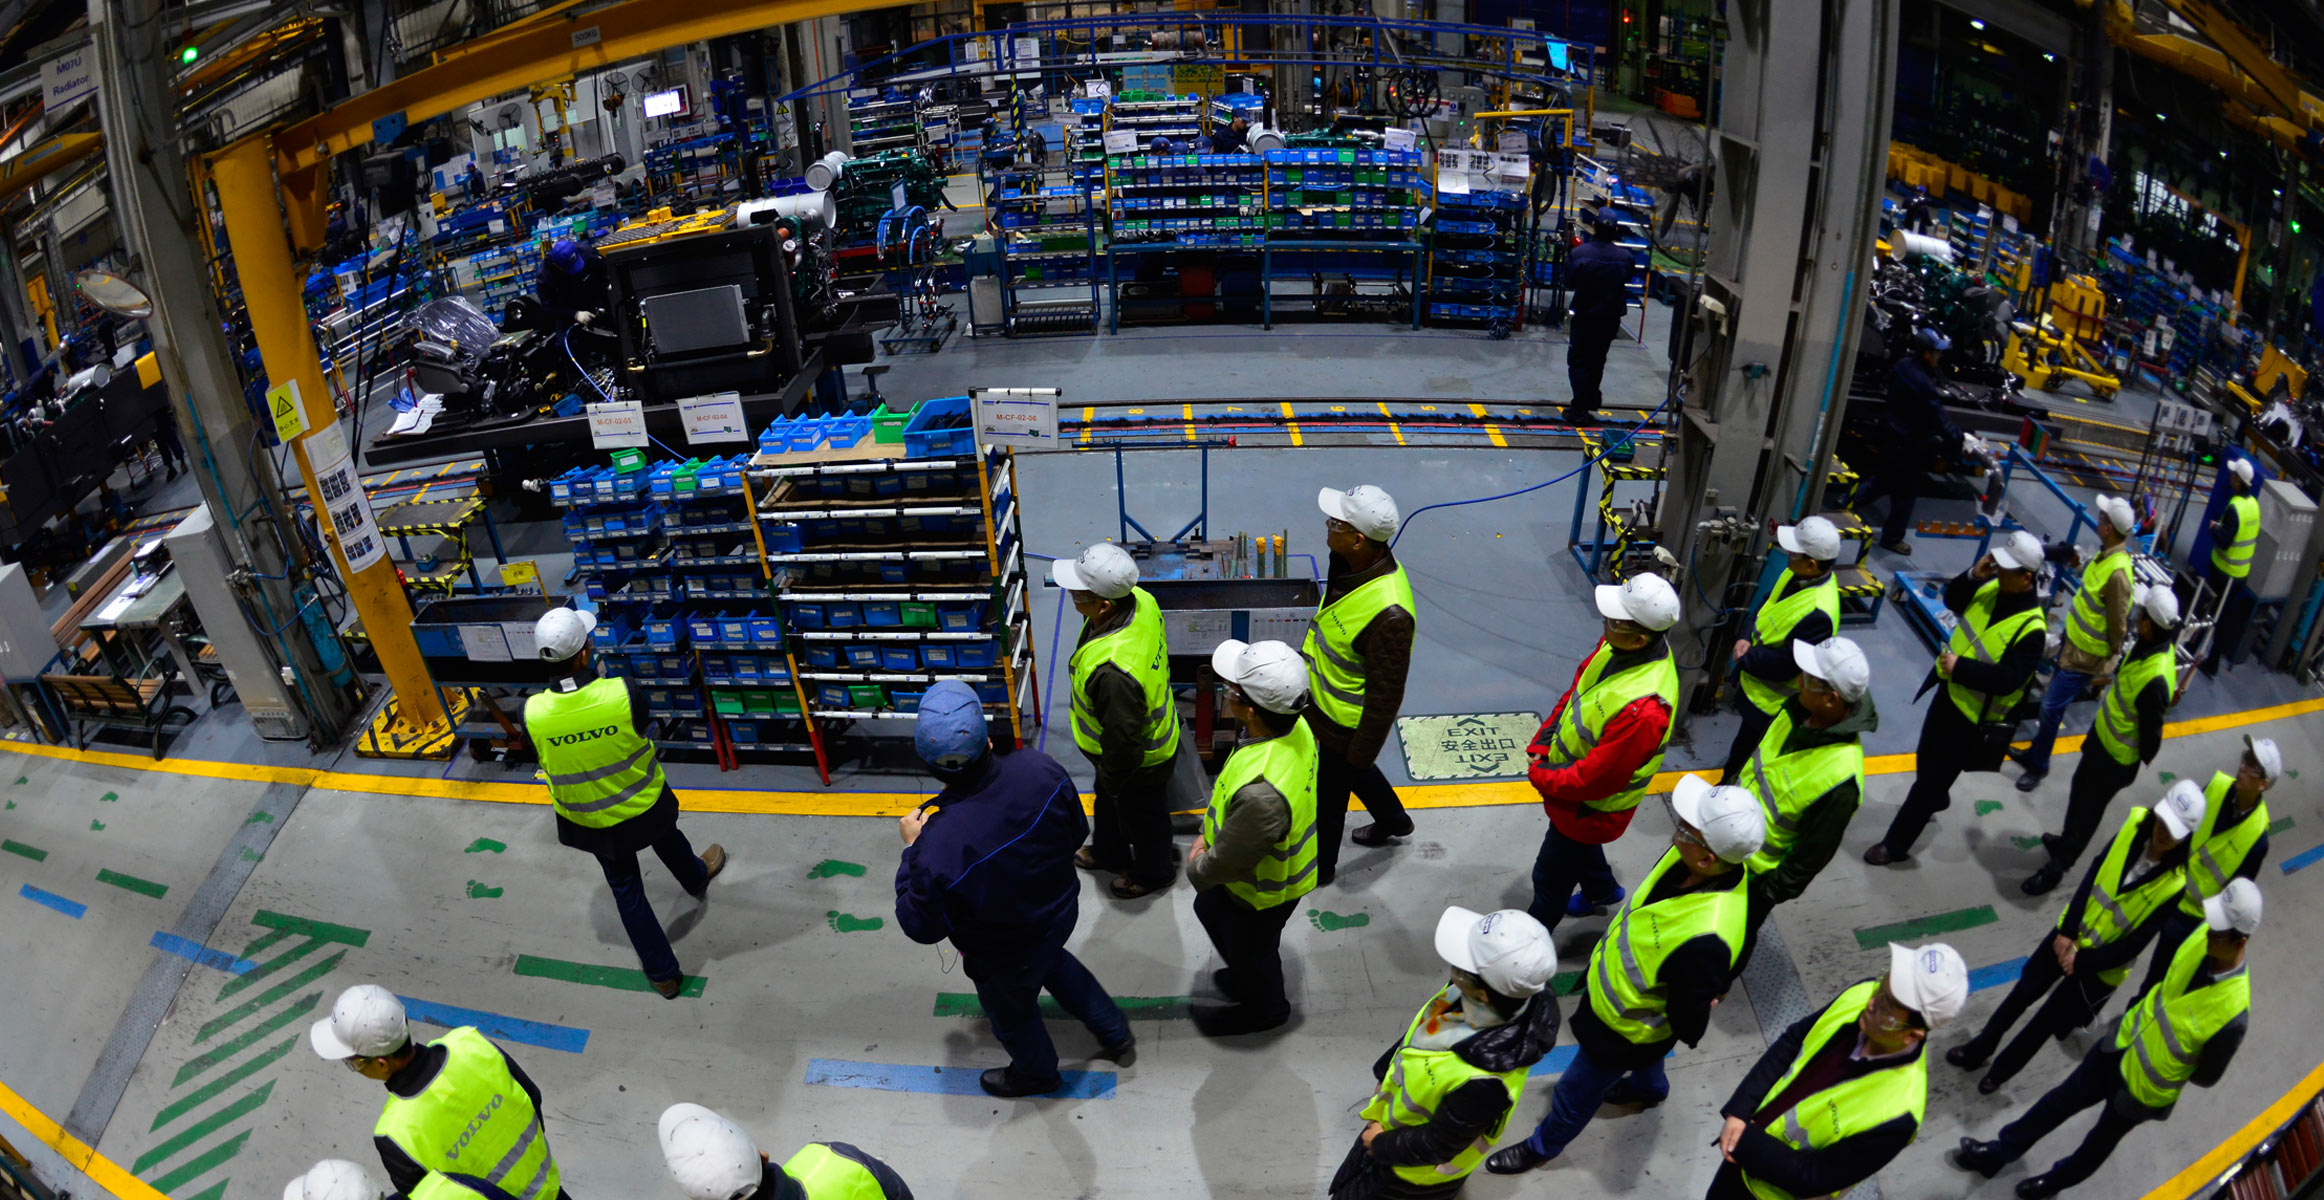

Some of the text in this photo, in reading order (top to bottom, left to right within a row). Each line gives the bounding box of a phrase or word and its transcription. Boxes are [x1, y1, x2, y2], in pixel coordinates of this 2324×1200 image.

[56, 57, 82, 75] M07U
[53, 75, 88, 96] Radiator
[996, 413, 1038, 422] M-CF-02-06
[546, 725, 618, 747] VOLVO
[1447, 727, 1500, 737] EXIT
[1441, 738, 1516, 752] 安全出口
[1455, 752, 1509, 763] EXIT
[446, 1093, 504, 1161] VOLVO
